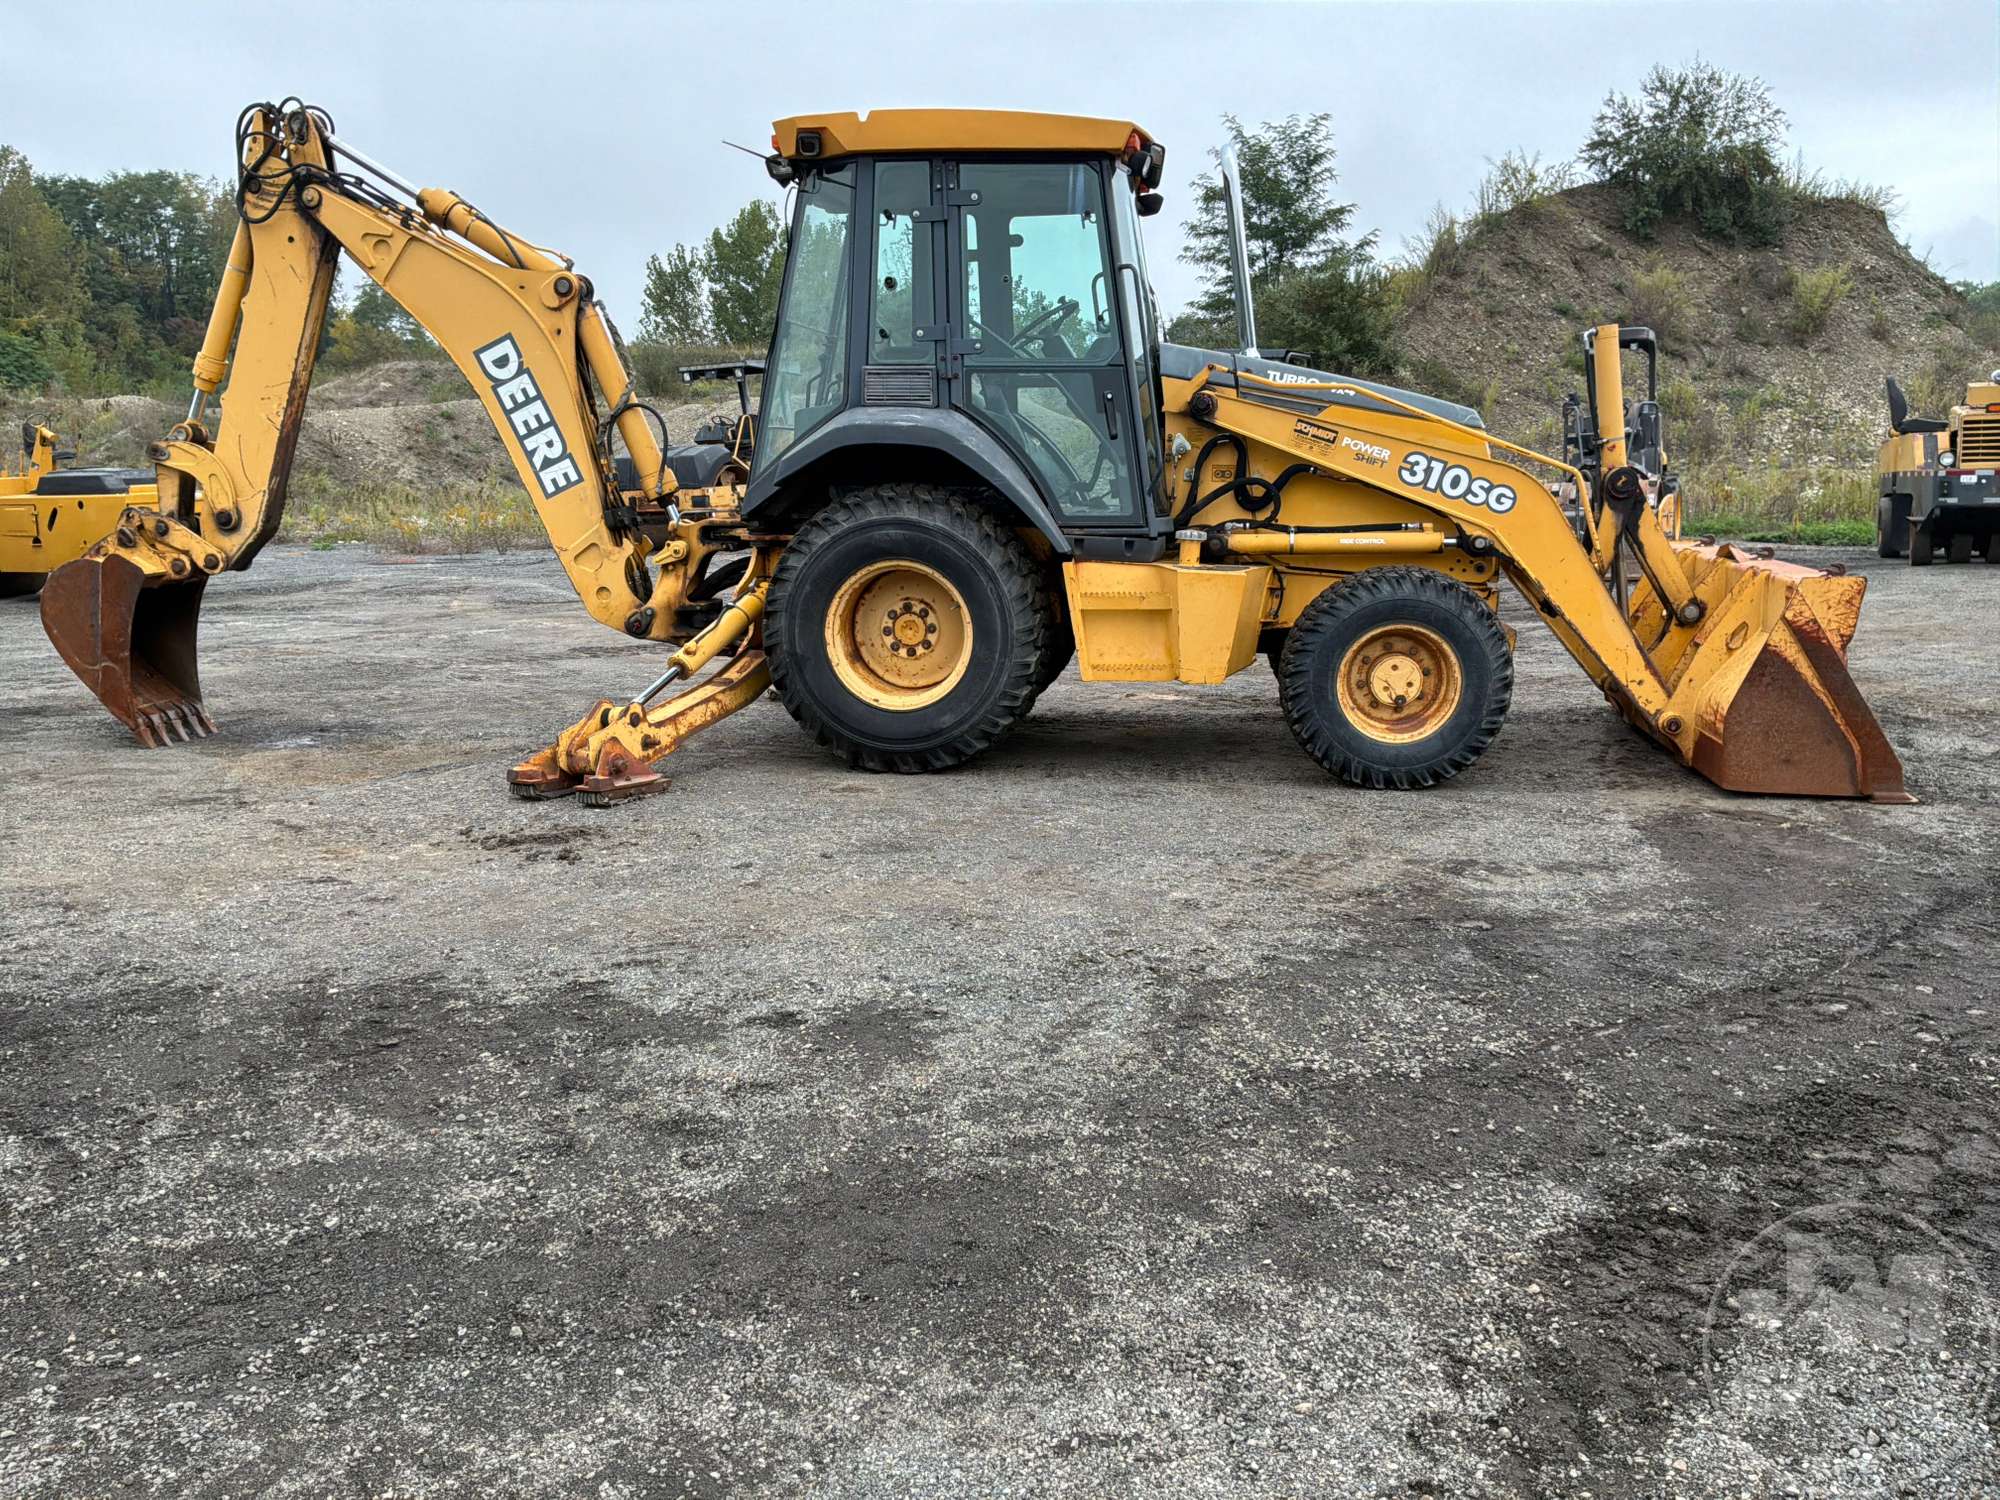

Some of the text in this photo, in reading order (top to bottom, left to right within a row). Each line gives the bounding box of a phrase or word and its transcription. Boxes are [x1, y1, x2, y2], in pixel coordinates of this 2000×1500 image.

[475, 335, 582, 497] DEERE
[1341, 436, 1391, 460] POWER
[1353, 452, 1388, 468] SHIFT
[1399, 452, 1516, 513] 310SG
